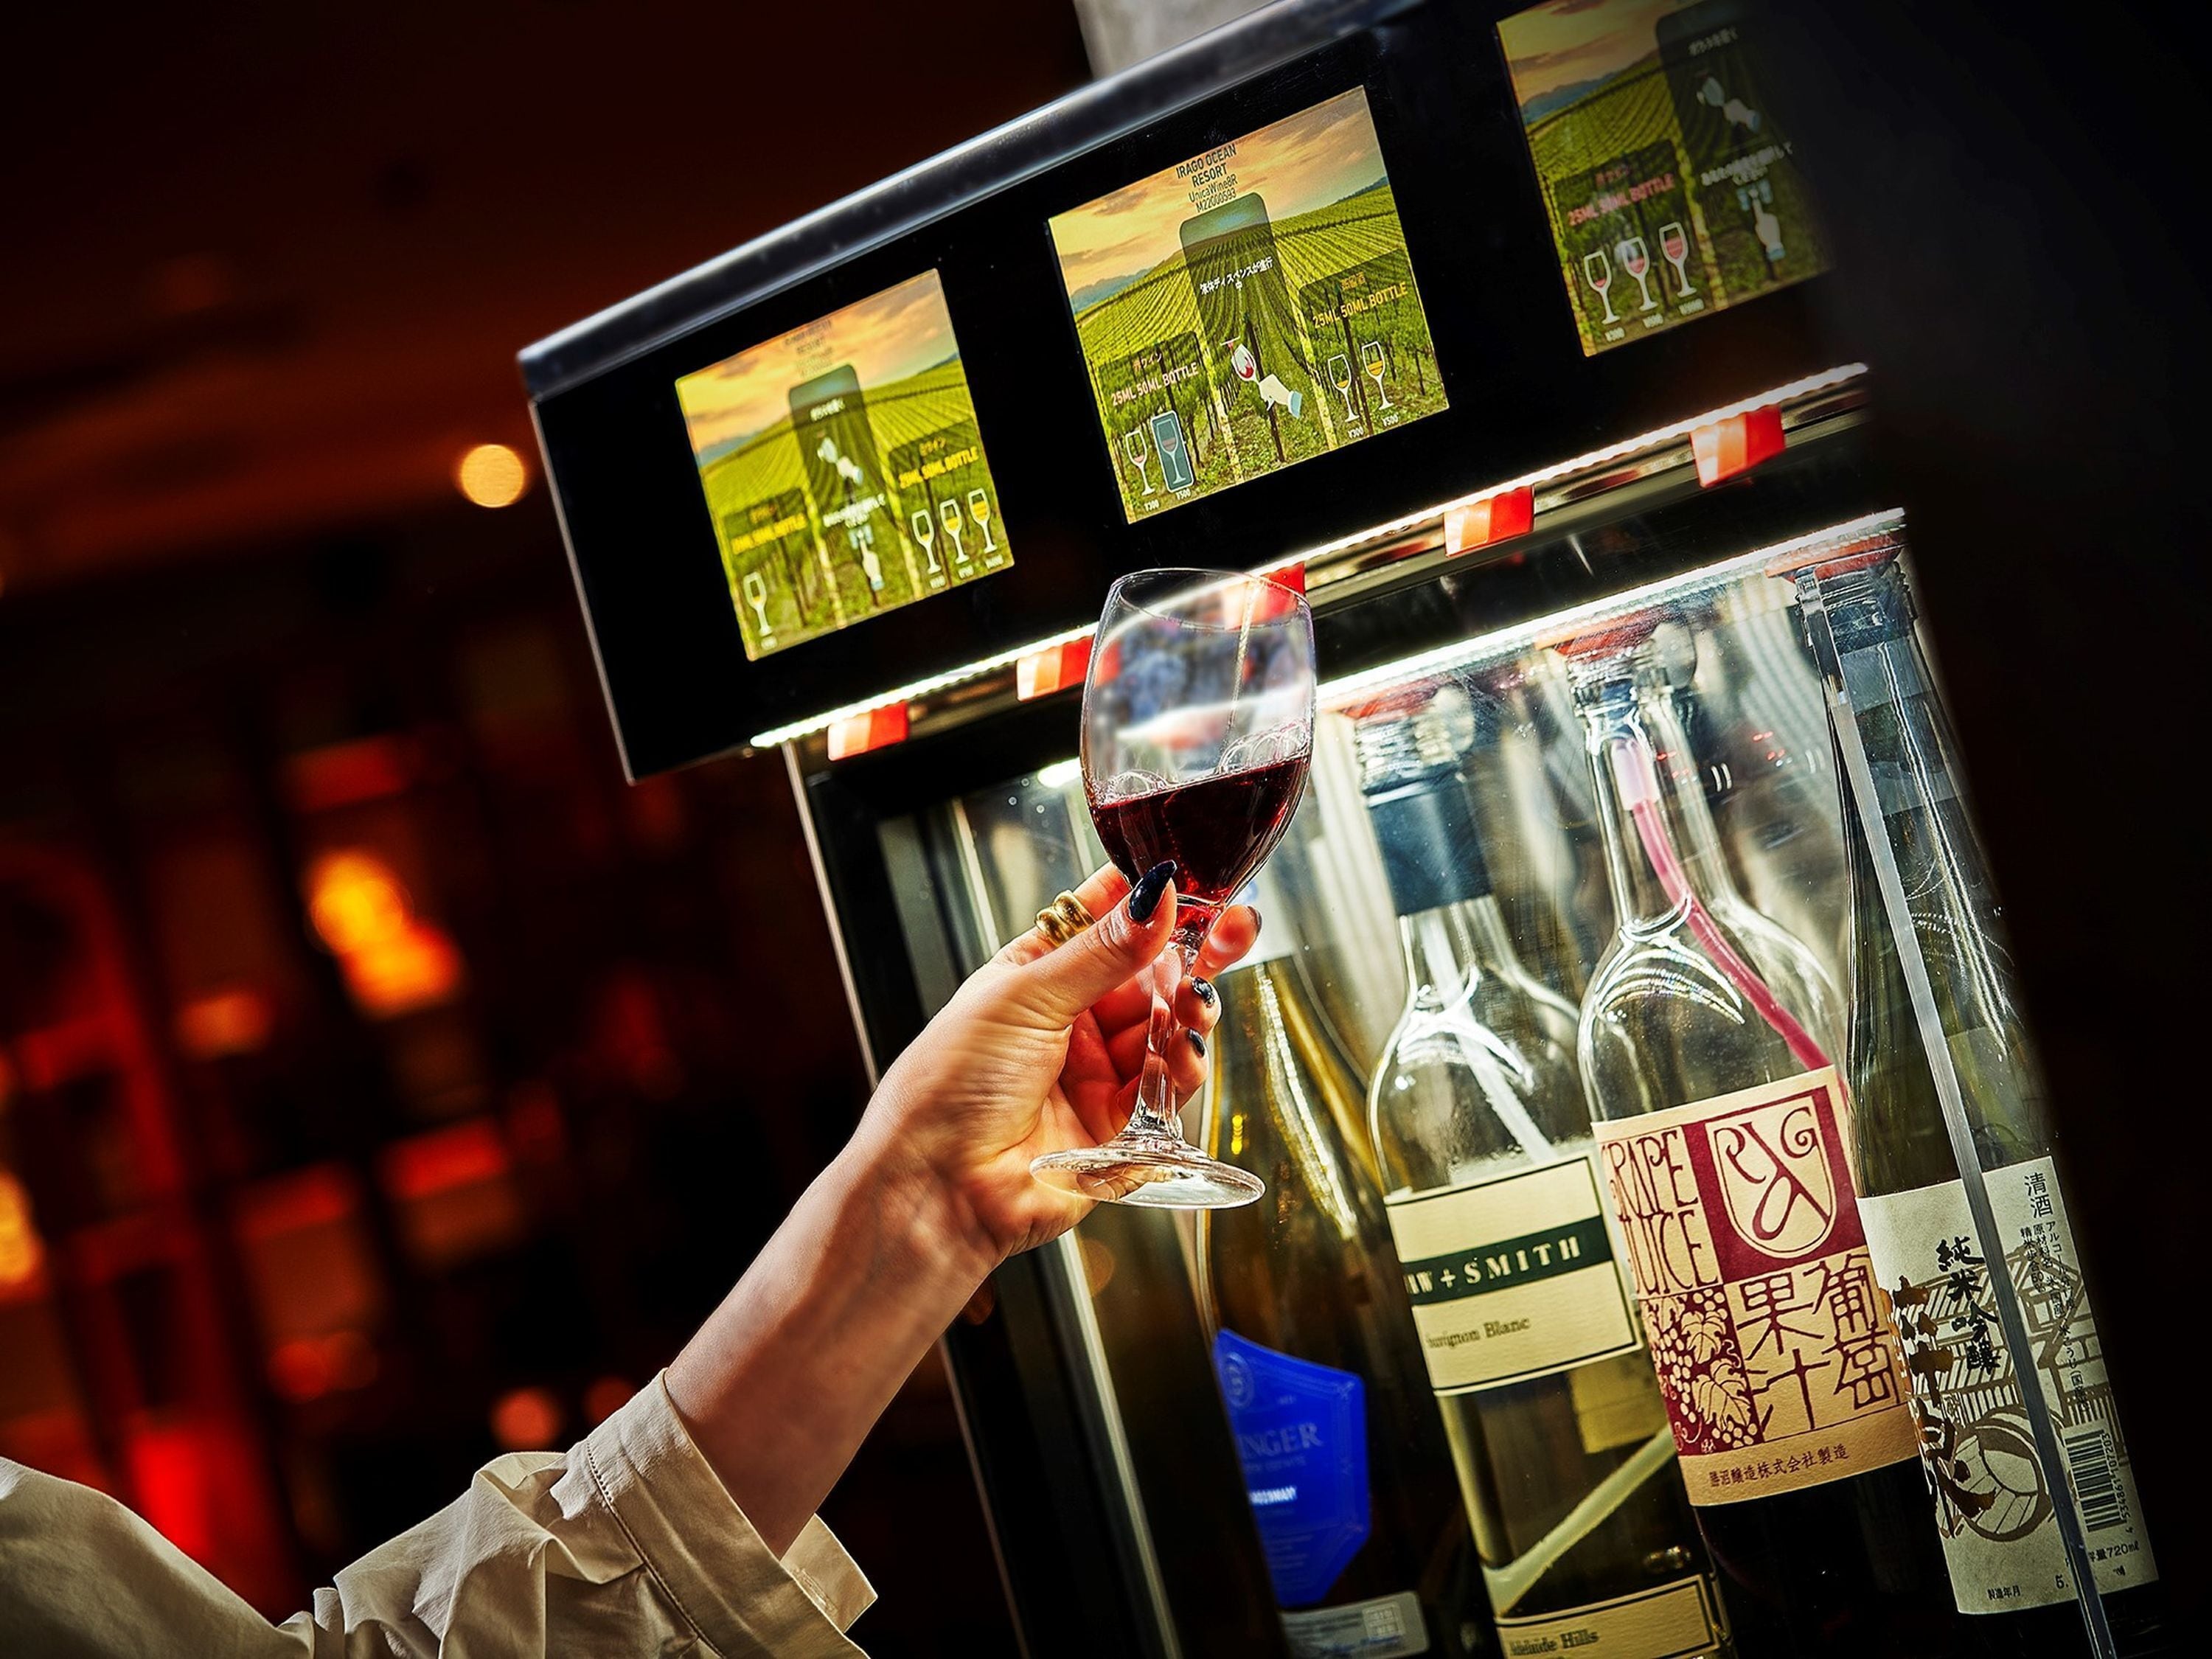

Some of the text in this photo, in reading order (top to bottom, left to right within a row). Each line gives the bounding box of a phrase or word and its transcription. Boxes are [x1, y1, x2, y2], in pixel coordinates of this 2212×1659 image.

[1175, 143, 1237, 178] IRAGO OCEAN
[1192, 162, 1228, 187] RESORT
[1312, 281, 1408, 329] 25ML 50ML BOTTLE
[1111, 361, 1200, 406] 25ML 50ML BOTTLE
[2024, 1172, 2053, 1218] 清酒
[1463, 1236, 1581, 1284] SMITH
[1483, 1317, 1531, 1339] Blanc
[1935, 1236, 2002, 1376] 純米吟醸
[2101, 1433, 2119, 1473] 107203
[2114, 1478, 2131, 1522] 534861
[1559, 1628, 1600, 1649] Hills
